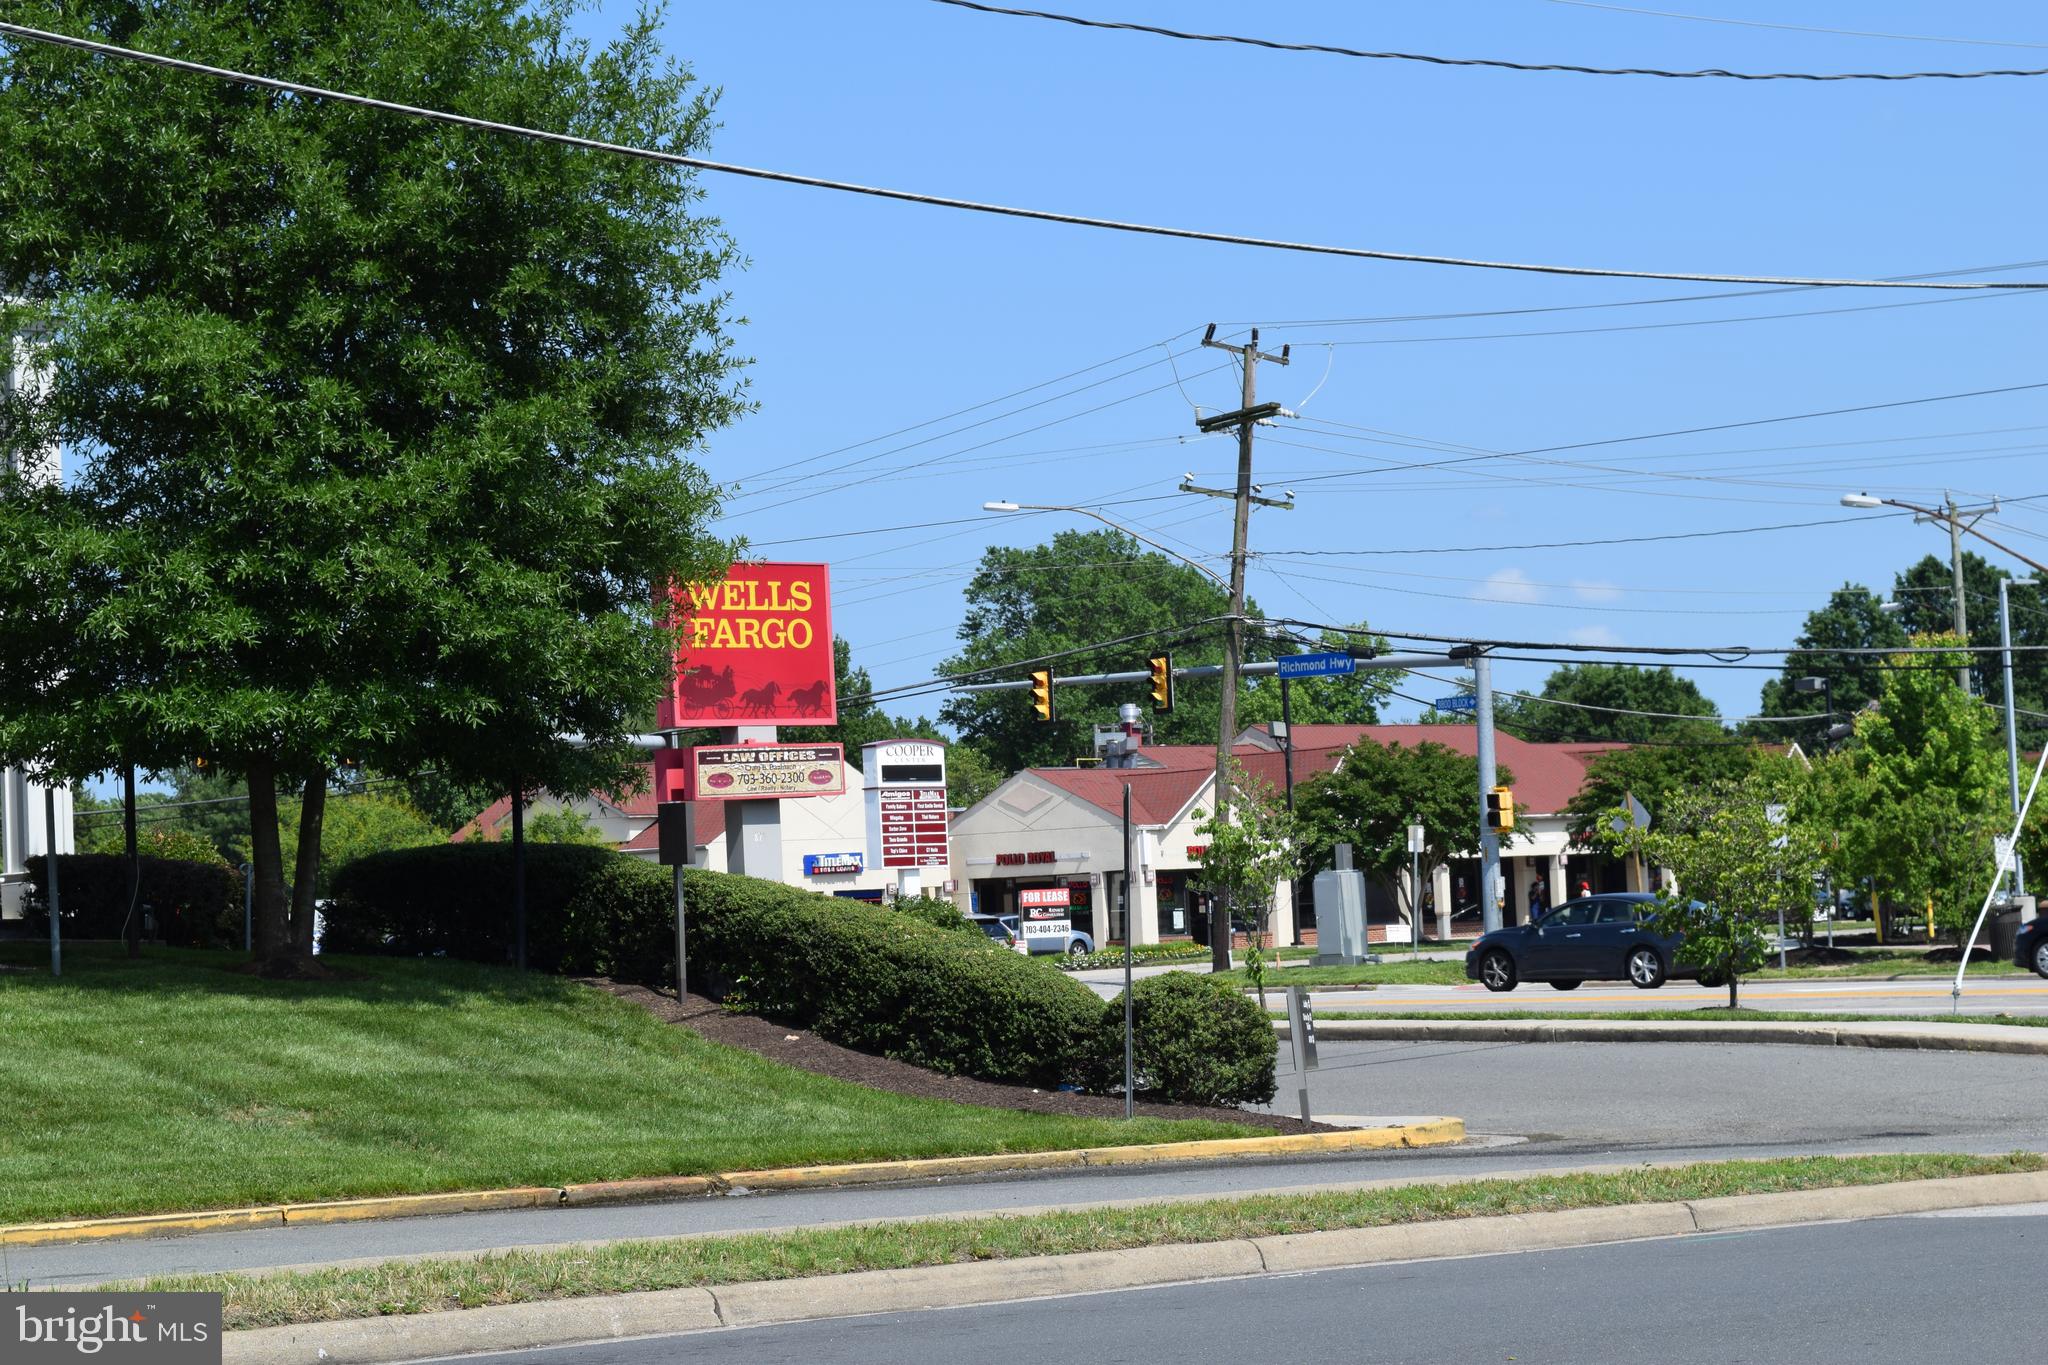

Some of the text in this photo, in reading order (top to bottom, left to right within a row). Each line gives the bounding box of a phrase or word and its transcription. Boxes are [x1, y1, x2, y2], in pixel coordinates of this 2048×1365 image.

[687, 580, 812, 612] WELLS
[690, 618, 813, 649] FARGO
[1281, 657, 1352, 674] Richmond Hwy
[723, 751, 816, 763] LAW OFFICES
[886, 744, 934, 757] COOPER
[737, 771, 805, 785] 703-360-2300
[881, 790, 911, 798] Amigos
[995, 851, 1057, 866] POLLO ROYAL
[1023, 890, 1069, 903] FOR LEASE
[1025, 924, 1069, 934] 703-404-2346
